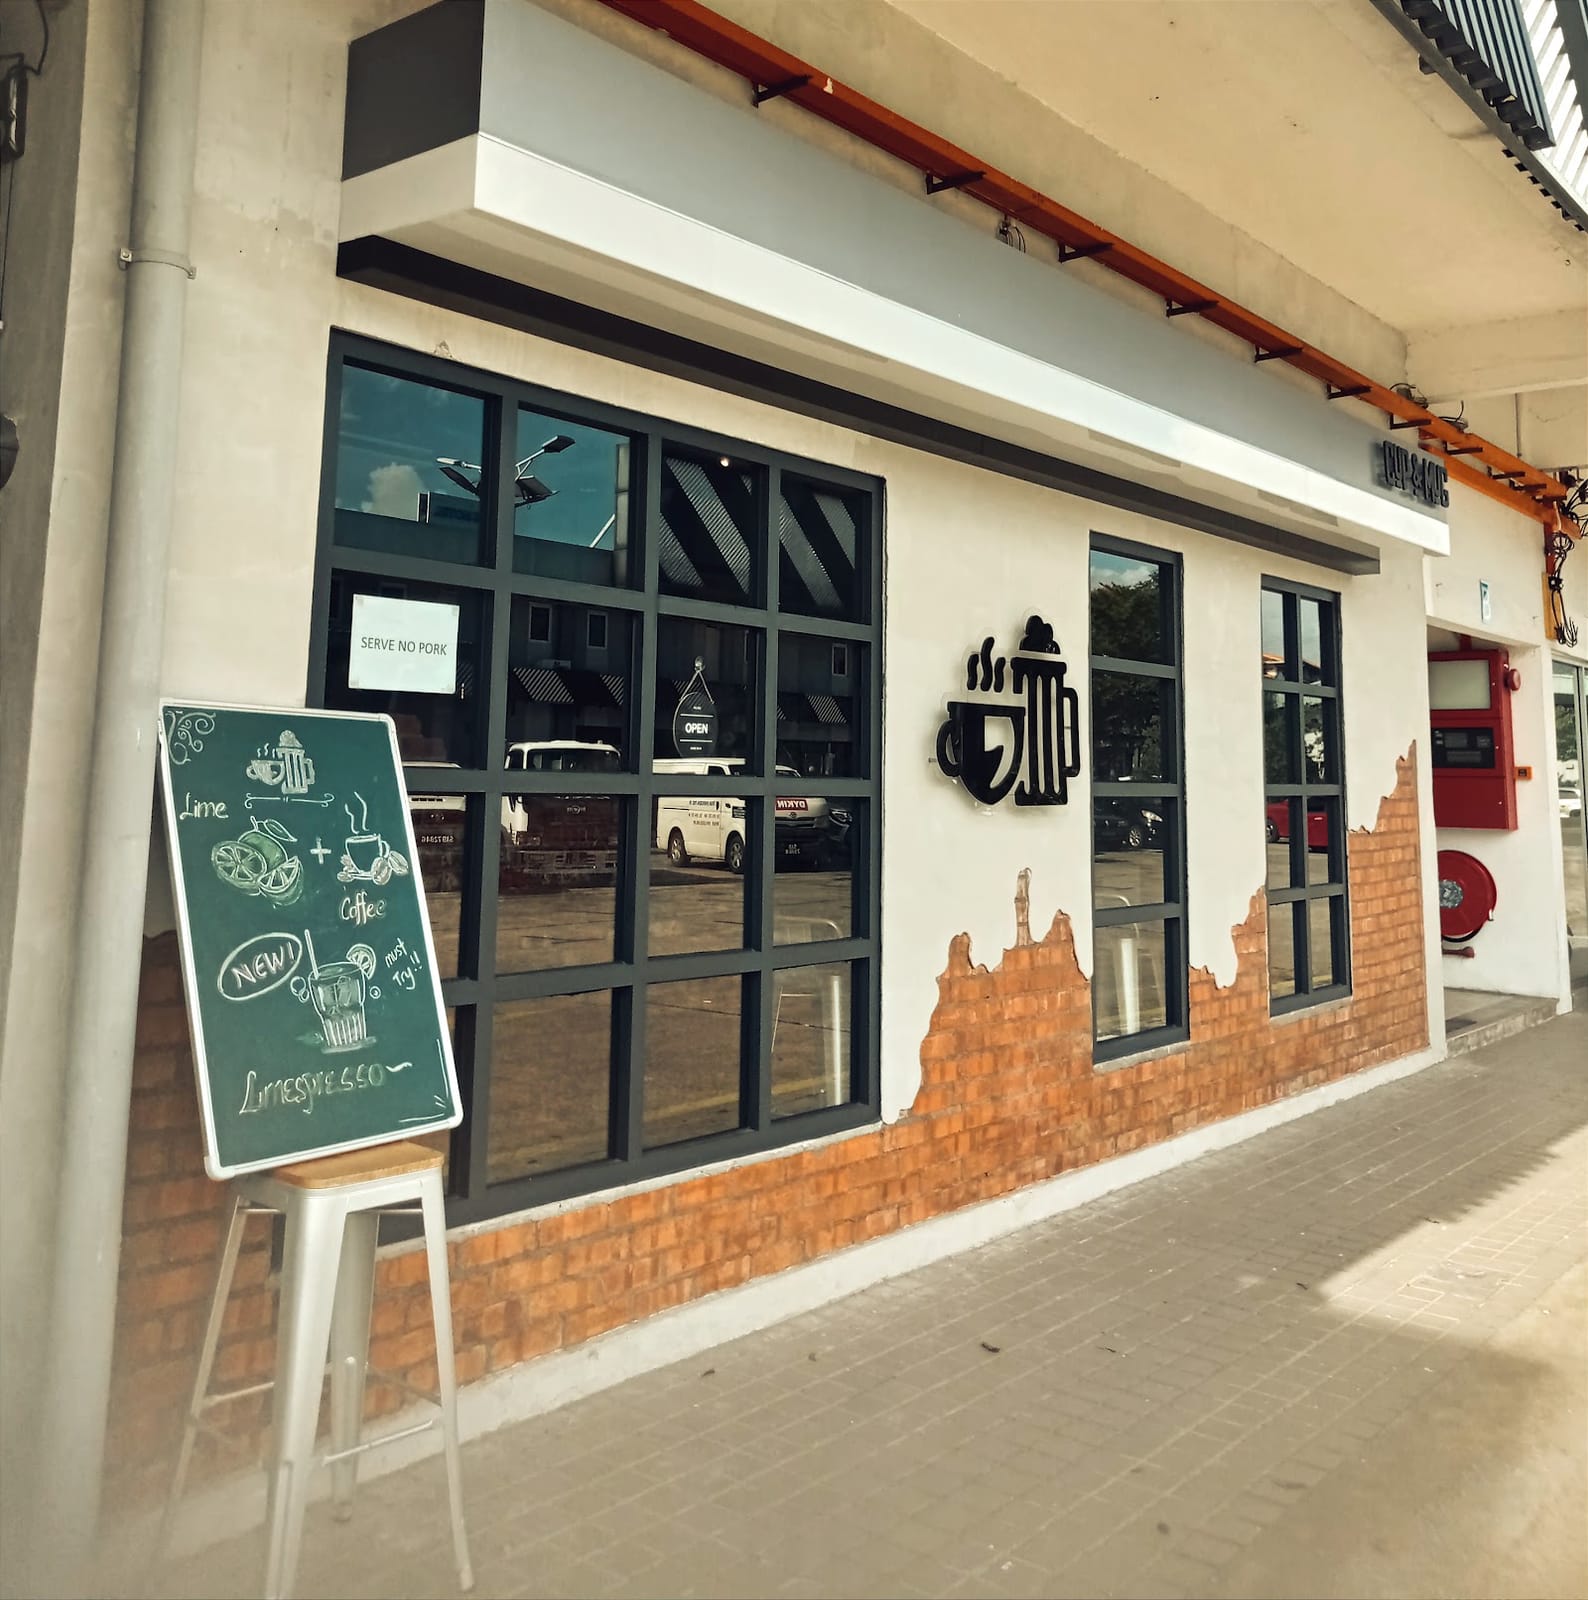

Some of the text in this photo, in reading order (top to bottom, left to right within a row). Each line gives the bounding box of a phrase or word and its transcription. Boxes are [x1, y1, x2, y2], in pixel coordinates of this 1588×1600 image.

[1382, 440, 1409, 491] CUP
[361, 637, 447, 656] SERVE NO PORK
[685, 722, 709, 734] OPEN
[179, 792, 229, 820] Lime
[340, 890, 385, 925] Coffee
